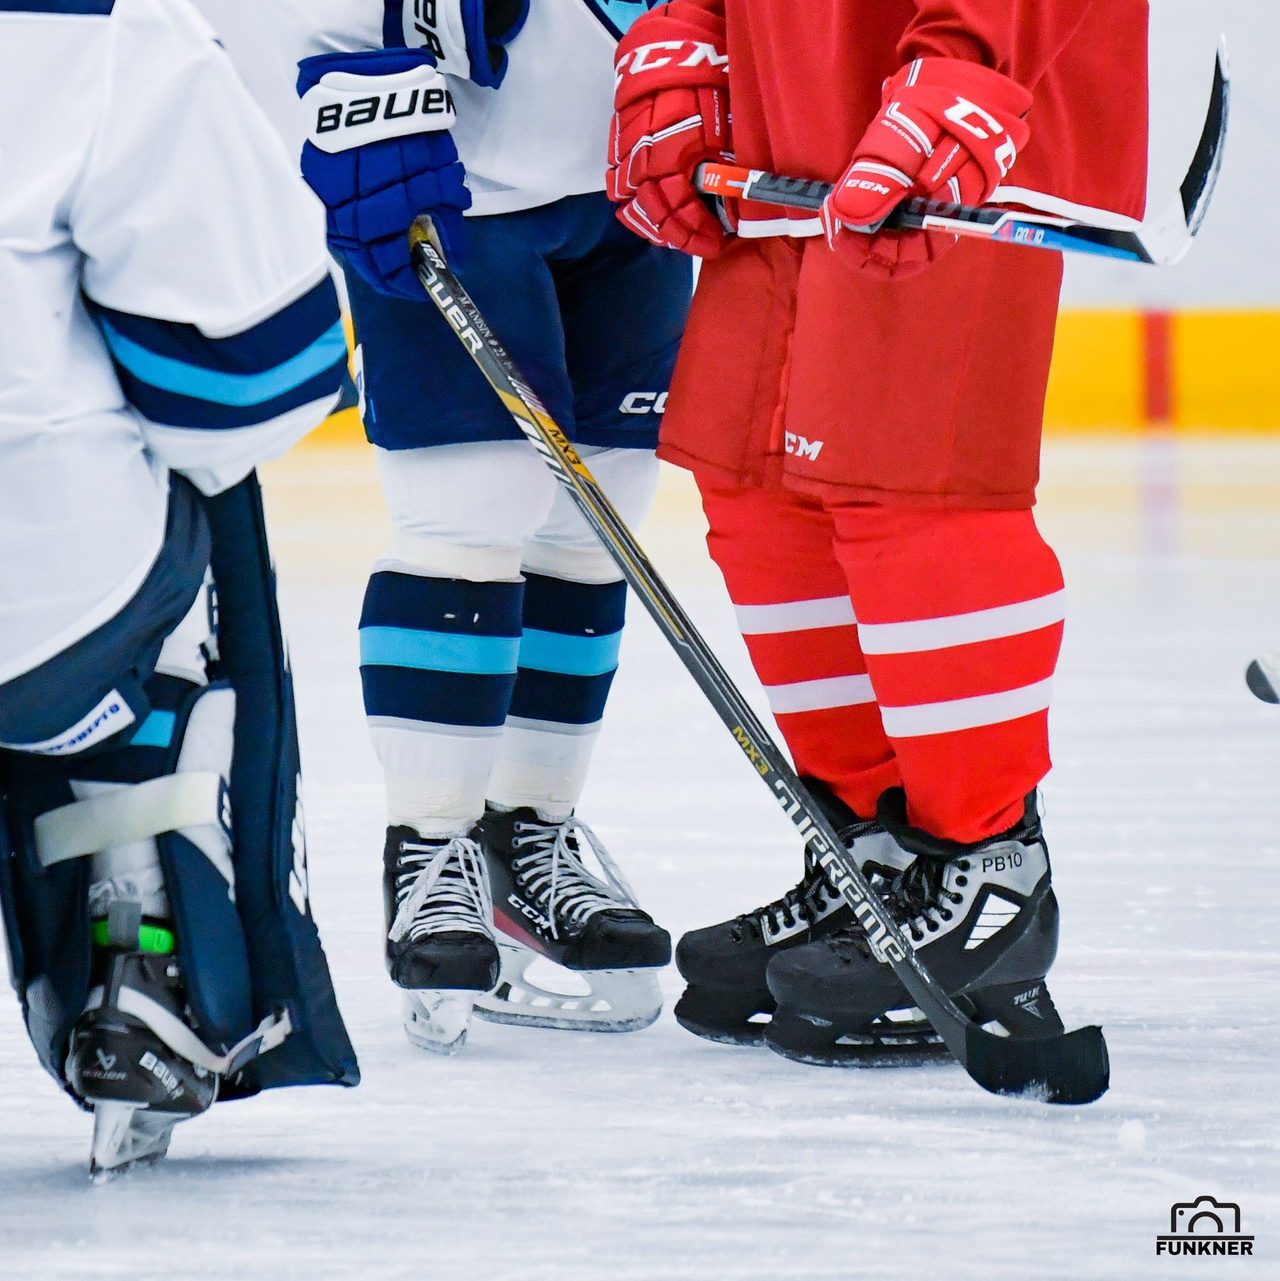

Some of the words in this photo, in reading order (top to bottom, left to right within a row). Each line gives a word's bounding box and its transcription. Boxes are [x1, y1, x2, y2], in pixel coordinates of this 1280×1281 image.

[846, 178, 891, 195] CCM
[549, 428, 582, 466] MX3
[732, 725, 769, 776] MX3
[774, 779, 906, 963] SUPREME
[982, 851, 1023, 873] PB10
